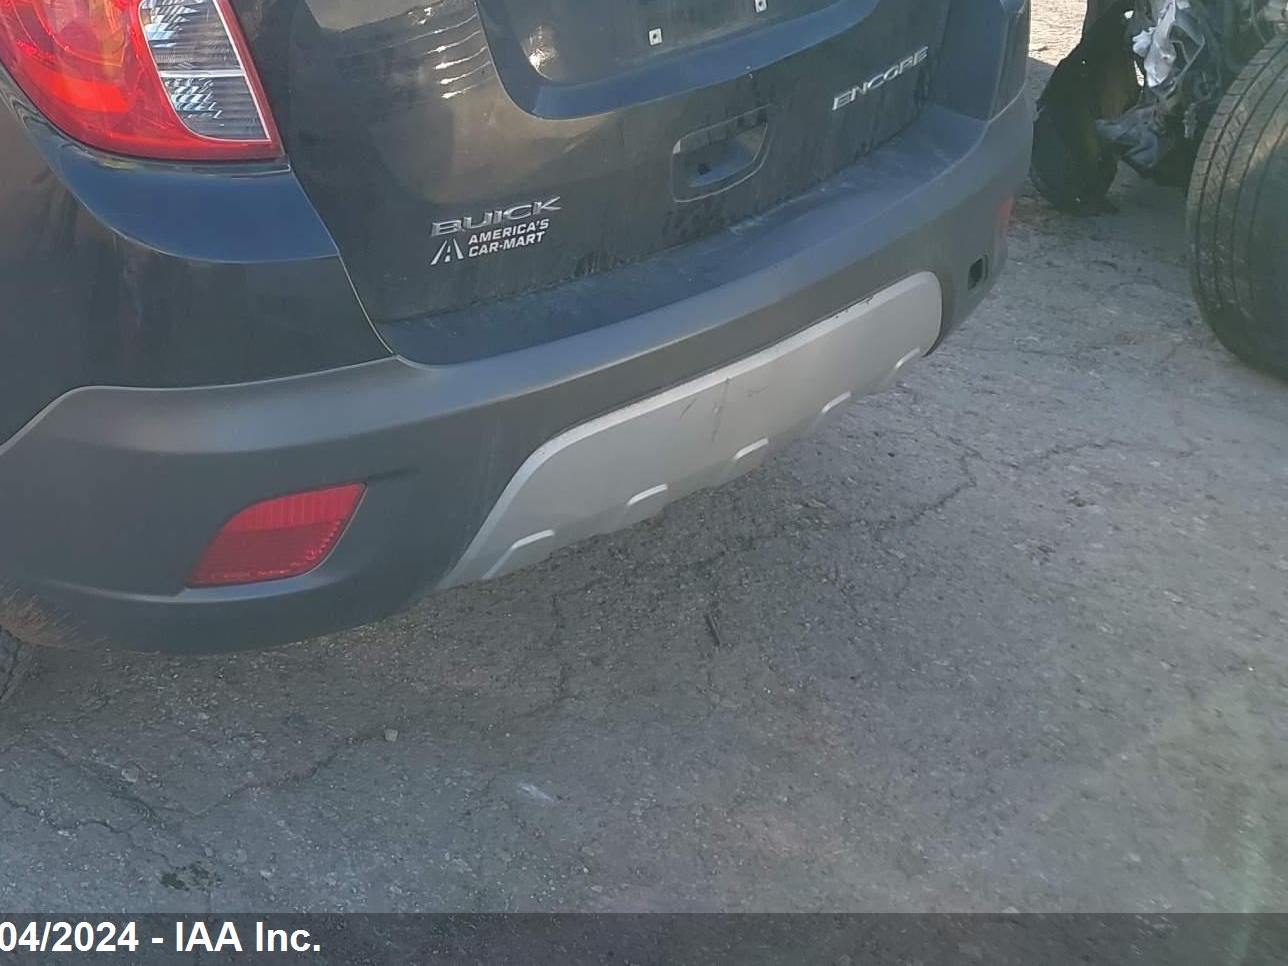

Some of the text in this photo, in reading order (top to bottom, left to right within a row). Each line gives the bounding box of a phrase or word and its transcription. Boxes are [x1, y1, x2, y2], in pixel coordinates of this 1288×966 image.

[832, 45, 929, 111] ENCORE
[430, 196, 561, 237] BUICK
[467, 218, 551, 245] AMERICA'S
[467, 231, 546, 258] CAR-MART
